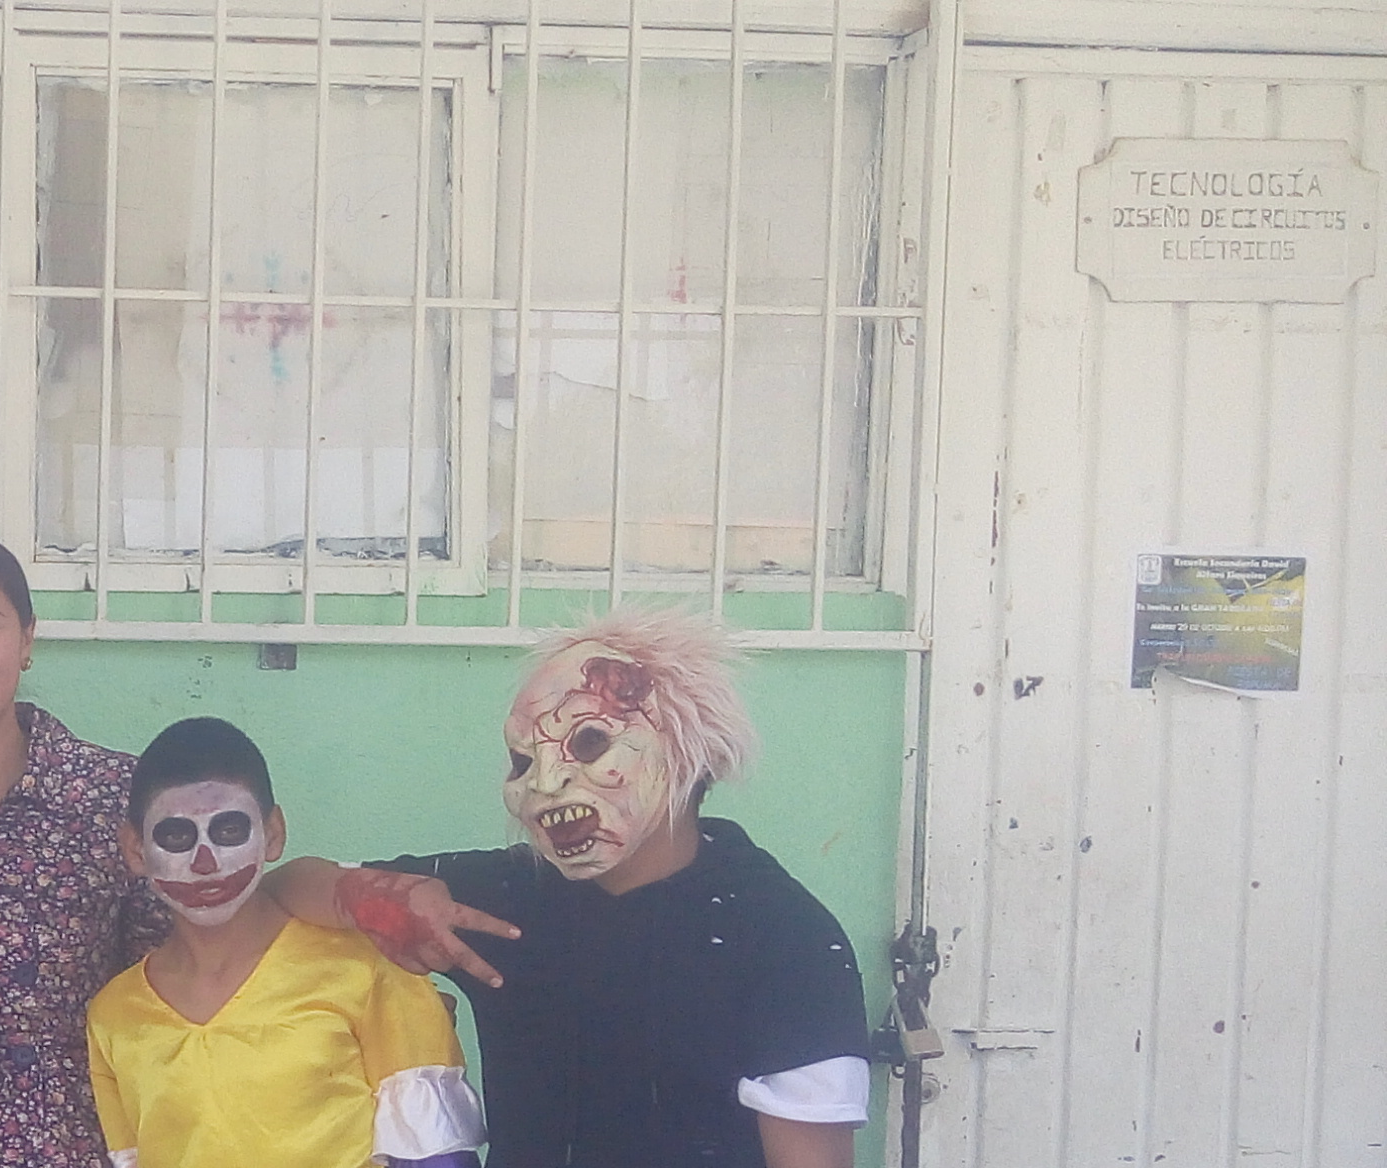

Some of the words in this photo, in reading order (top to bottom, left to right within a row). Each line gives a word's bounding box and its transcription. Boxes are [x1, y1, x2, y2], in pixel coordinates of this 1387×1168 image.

[1130, 168, 1323, 198] TECNOLOGÍA
[1113, 205, 1191, 229] DISEÑO
[1201, 208, 1229, 228] DE
[1231, 208, 1346, 230] CIRCUITOS
[1162, 236, 1295, 261] ELÉCTRICOS
